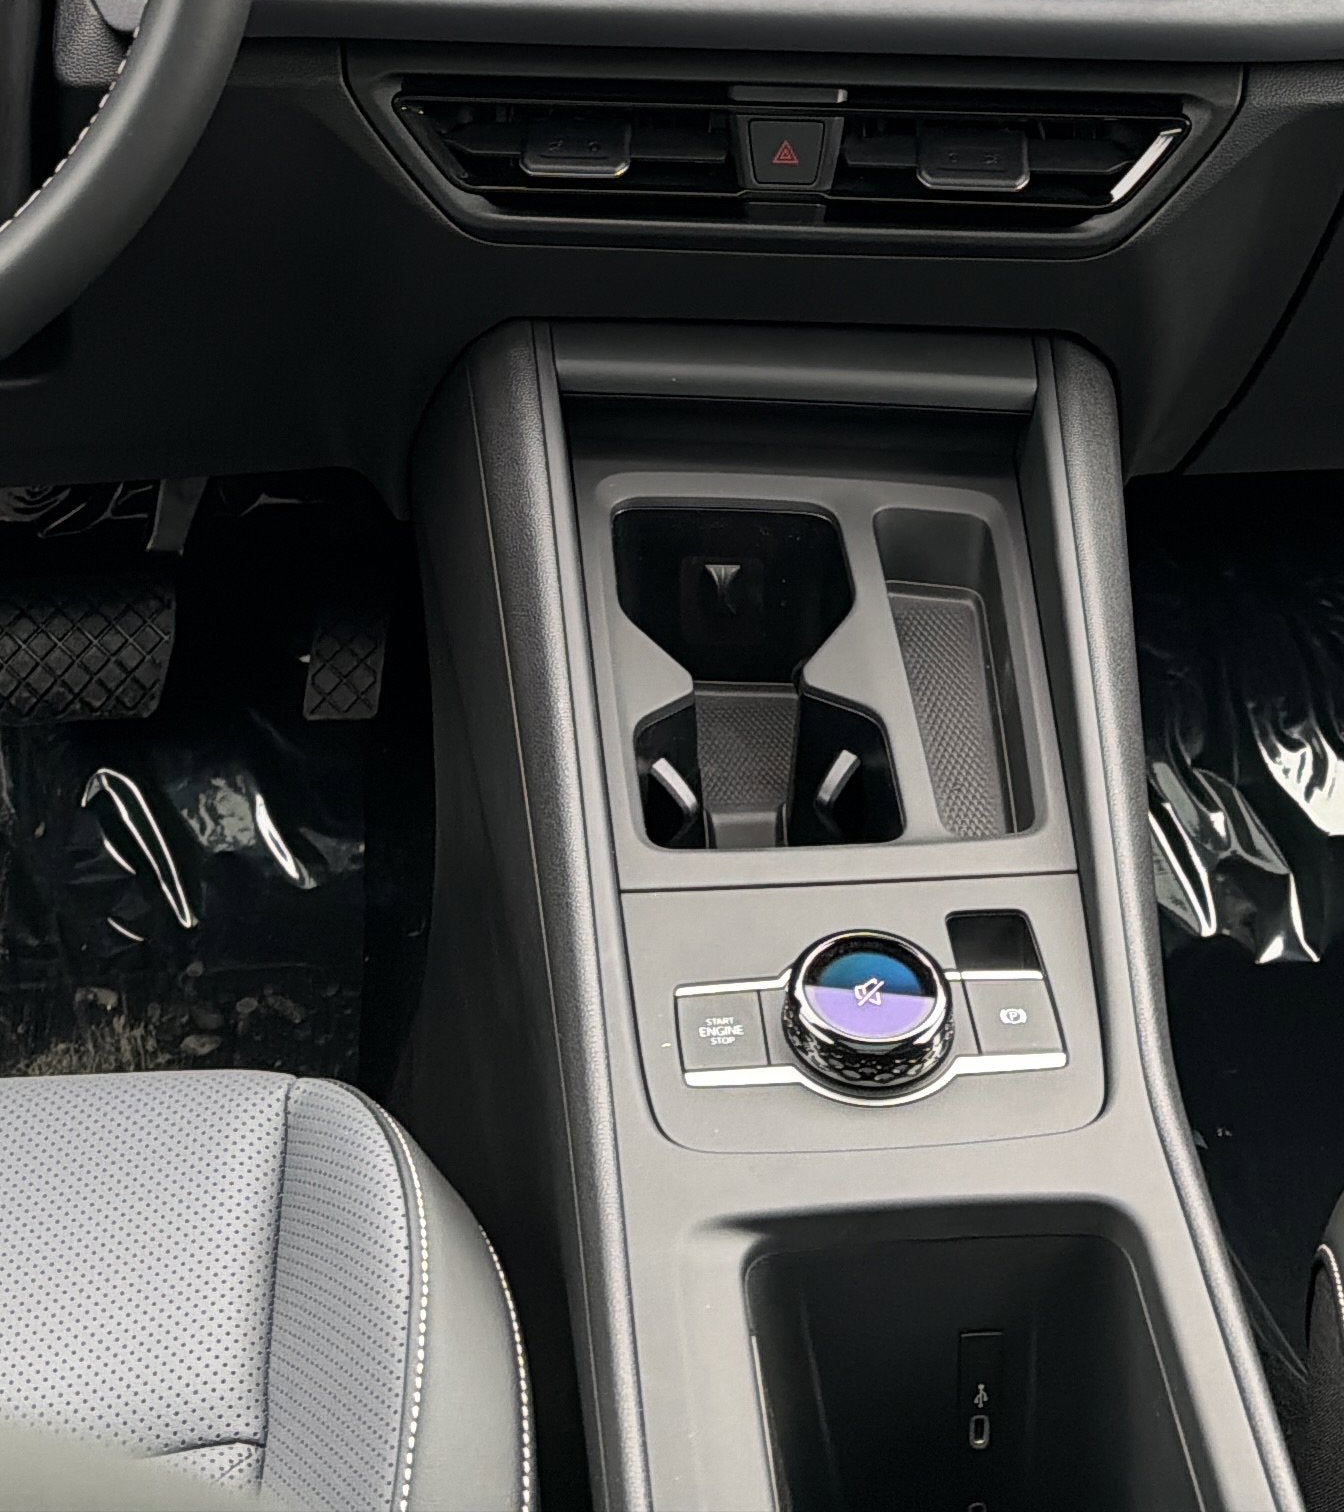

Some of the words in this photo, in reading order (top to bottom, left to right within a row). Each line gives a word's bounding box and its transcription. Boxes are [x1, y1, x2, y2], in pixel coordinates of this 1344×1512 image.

[705, 1016, 734, 1026] START
[698, 1024, 745, 1038] ENGINE
[710, 1036, 736, 1046] STOP
